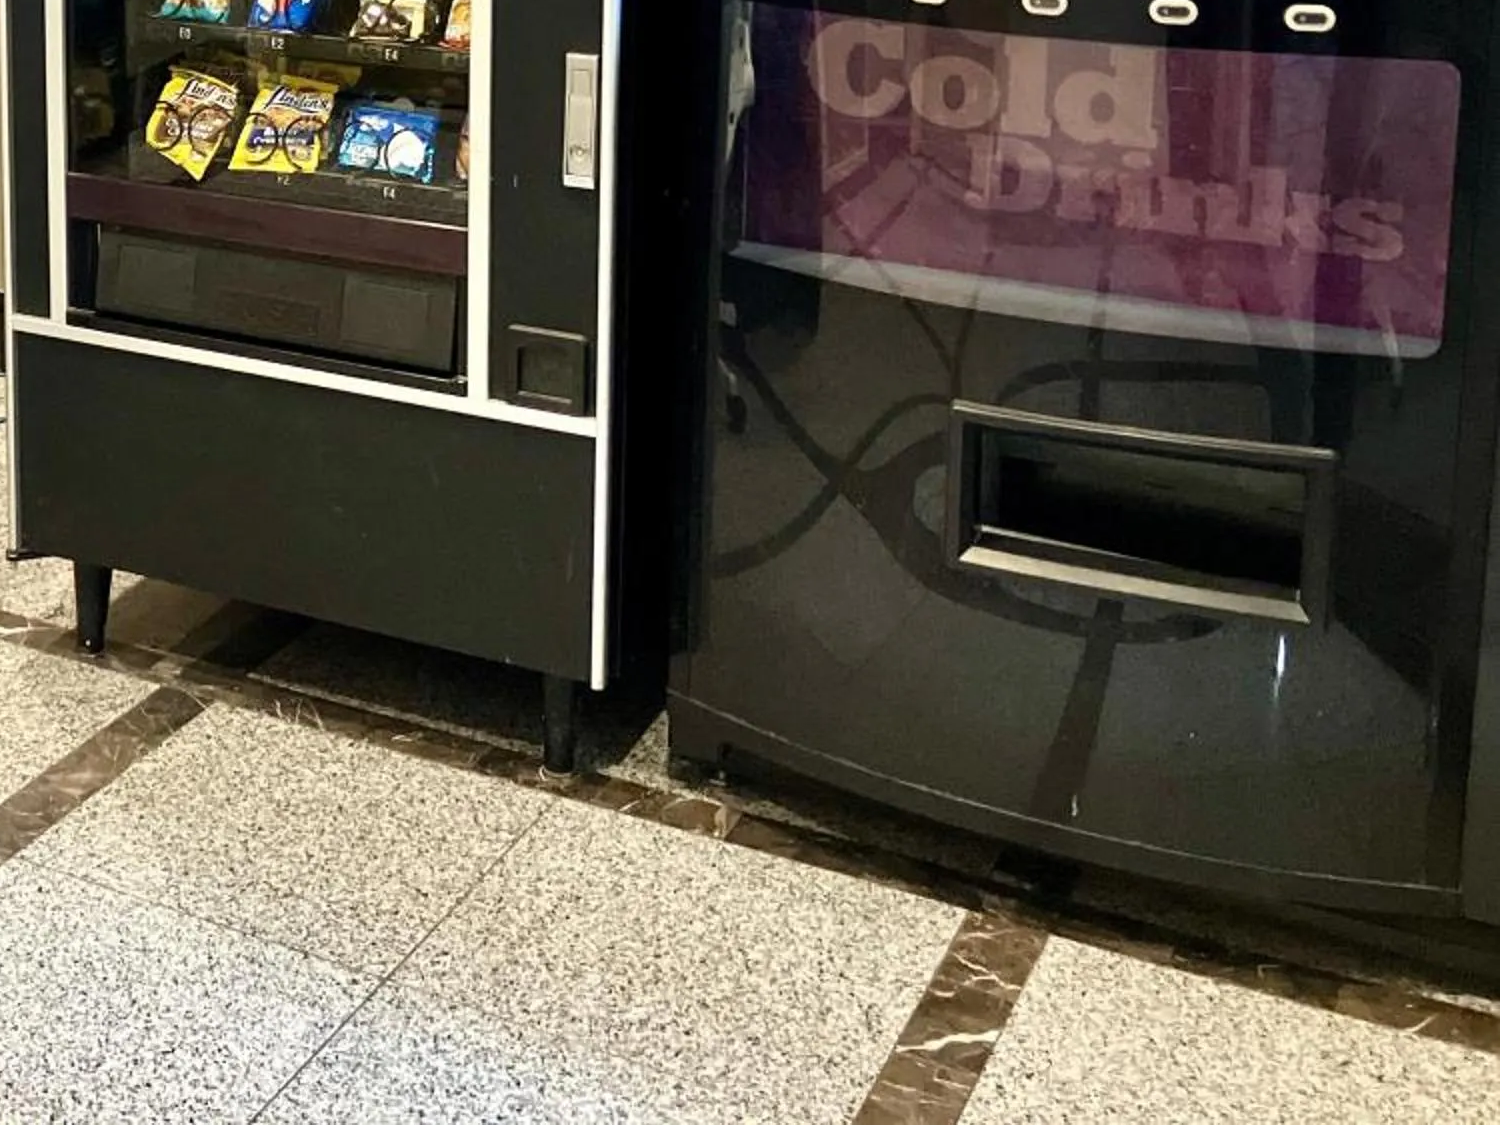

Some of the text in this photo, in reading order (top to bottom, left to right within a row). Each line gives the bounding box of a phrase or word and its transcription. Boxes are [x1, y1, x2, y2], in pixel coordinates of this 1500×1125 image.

[385, 48, 398, 62] E4
[811, 19, 1157, 148] Cold
[966, 134, 1403, 261] Drinks
